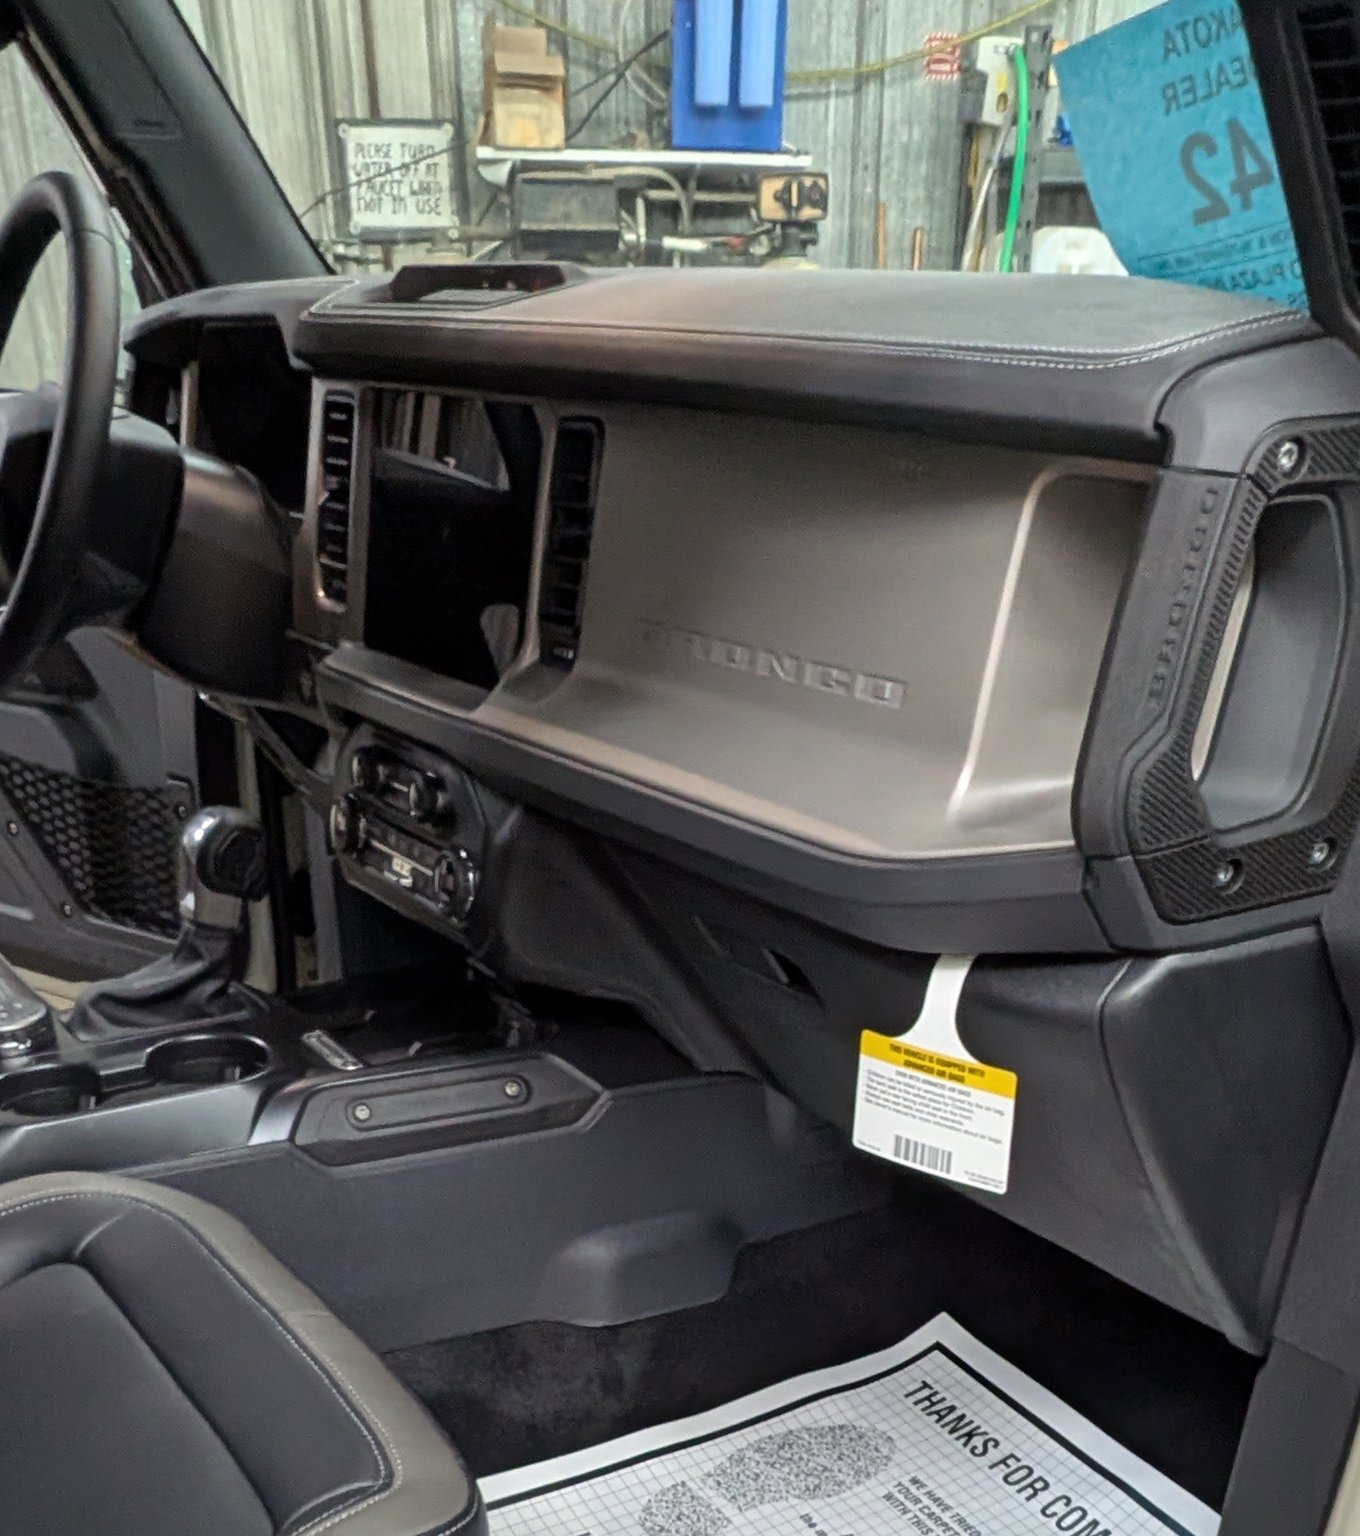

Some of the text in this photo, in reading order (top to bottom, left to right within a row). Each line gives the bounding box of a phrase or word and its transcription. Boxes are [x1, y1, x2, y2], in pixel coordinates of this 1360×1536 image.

[636, 616, 907, 709] ONCO
[903, 1380, 1001, 1458] THANKS
[987, 1453, 1051, 1503] FOR
[882, 1491, 912, 1516] WITH
[907, 1513, 934, 1536] THIS
[893, 1481, 922, 1506] YOUR
[908, 1475, 929, 1491] WE
[923, 1490, 954, 1514] HAVE
[800, 1513, 818, 1529] the
